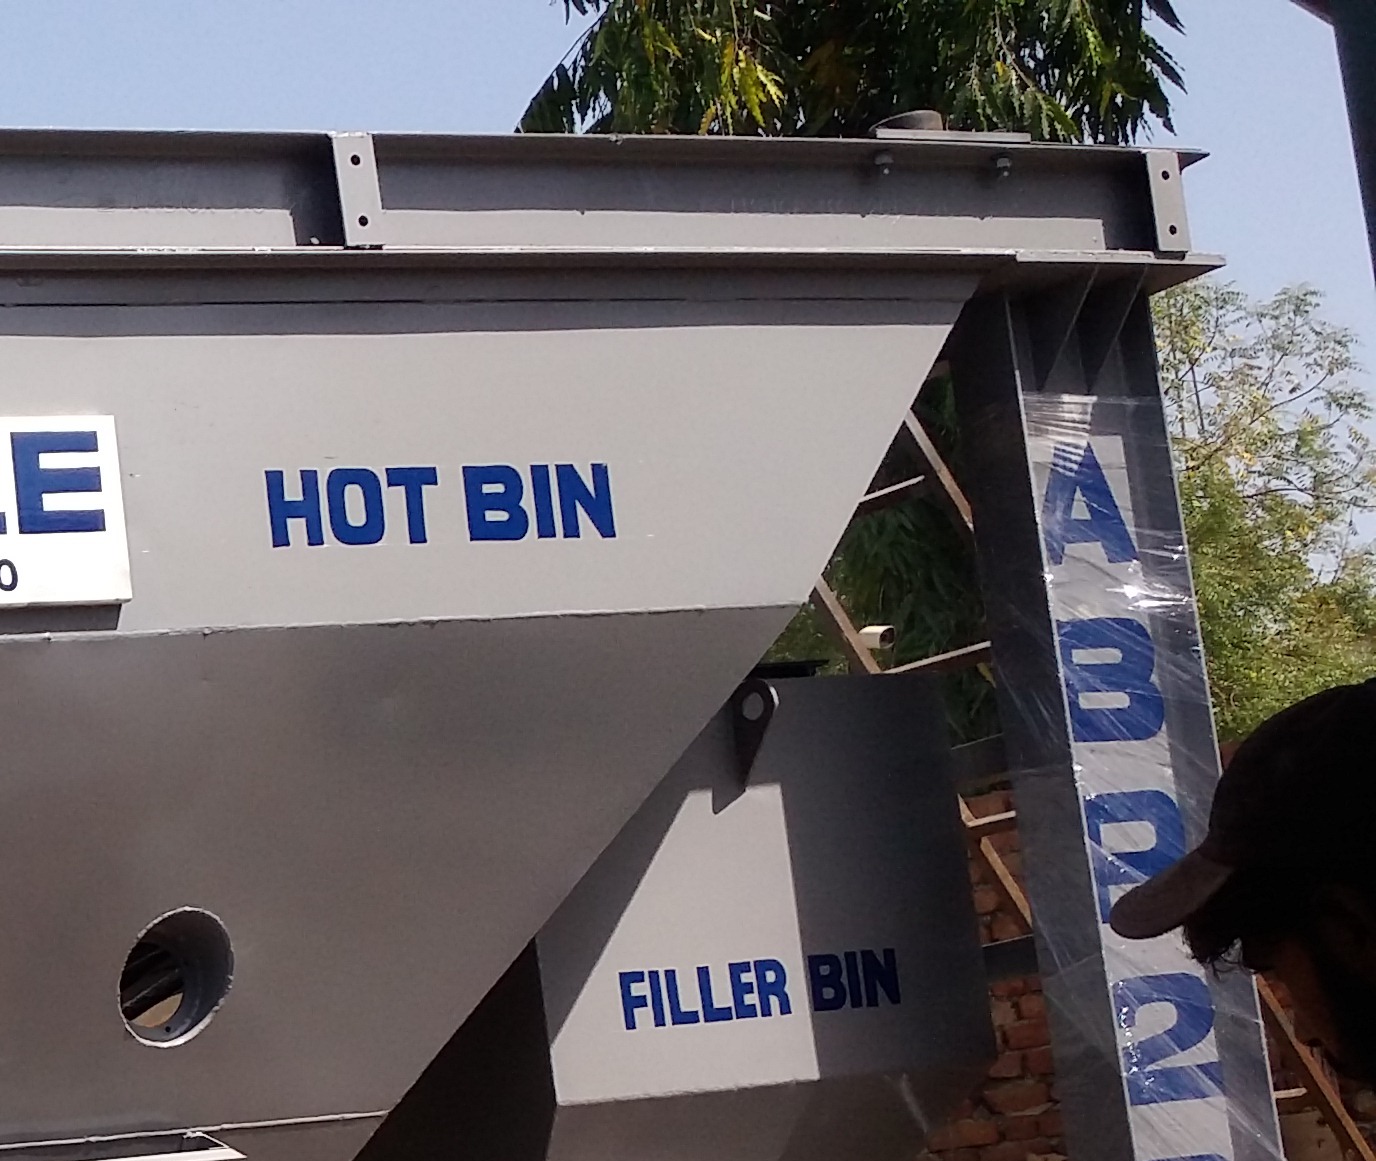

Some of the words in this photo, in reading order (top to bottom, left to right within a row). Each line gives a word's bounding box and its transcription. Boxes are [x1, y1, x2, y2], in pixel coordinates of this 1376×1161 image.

[263, 466, 439, 549] HOT
[461, 462, 618, 543] BIN
[617, 957, 793, 1031] FILLER
[806, 947, 902, 1014] BIN
